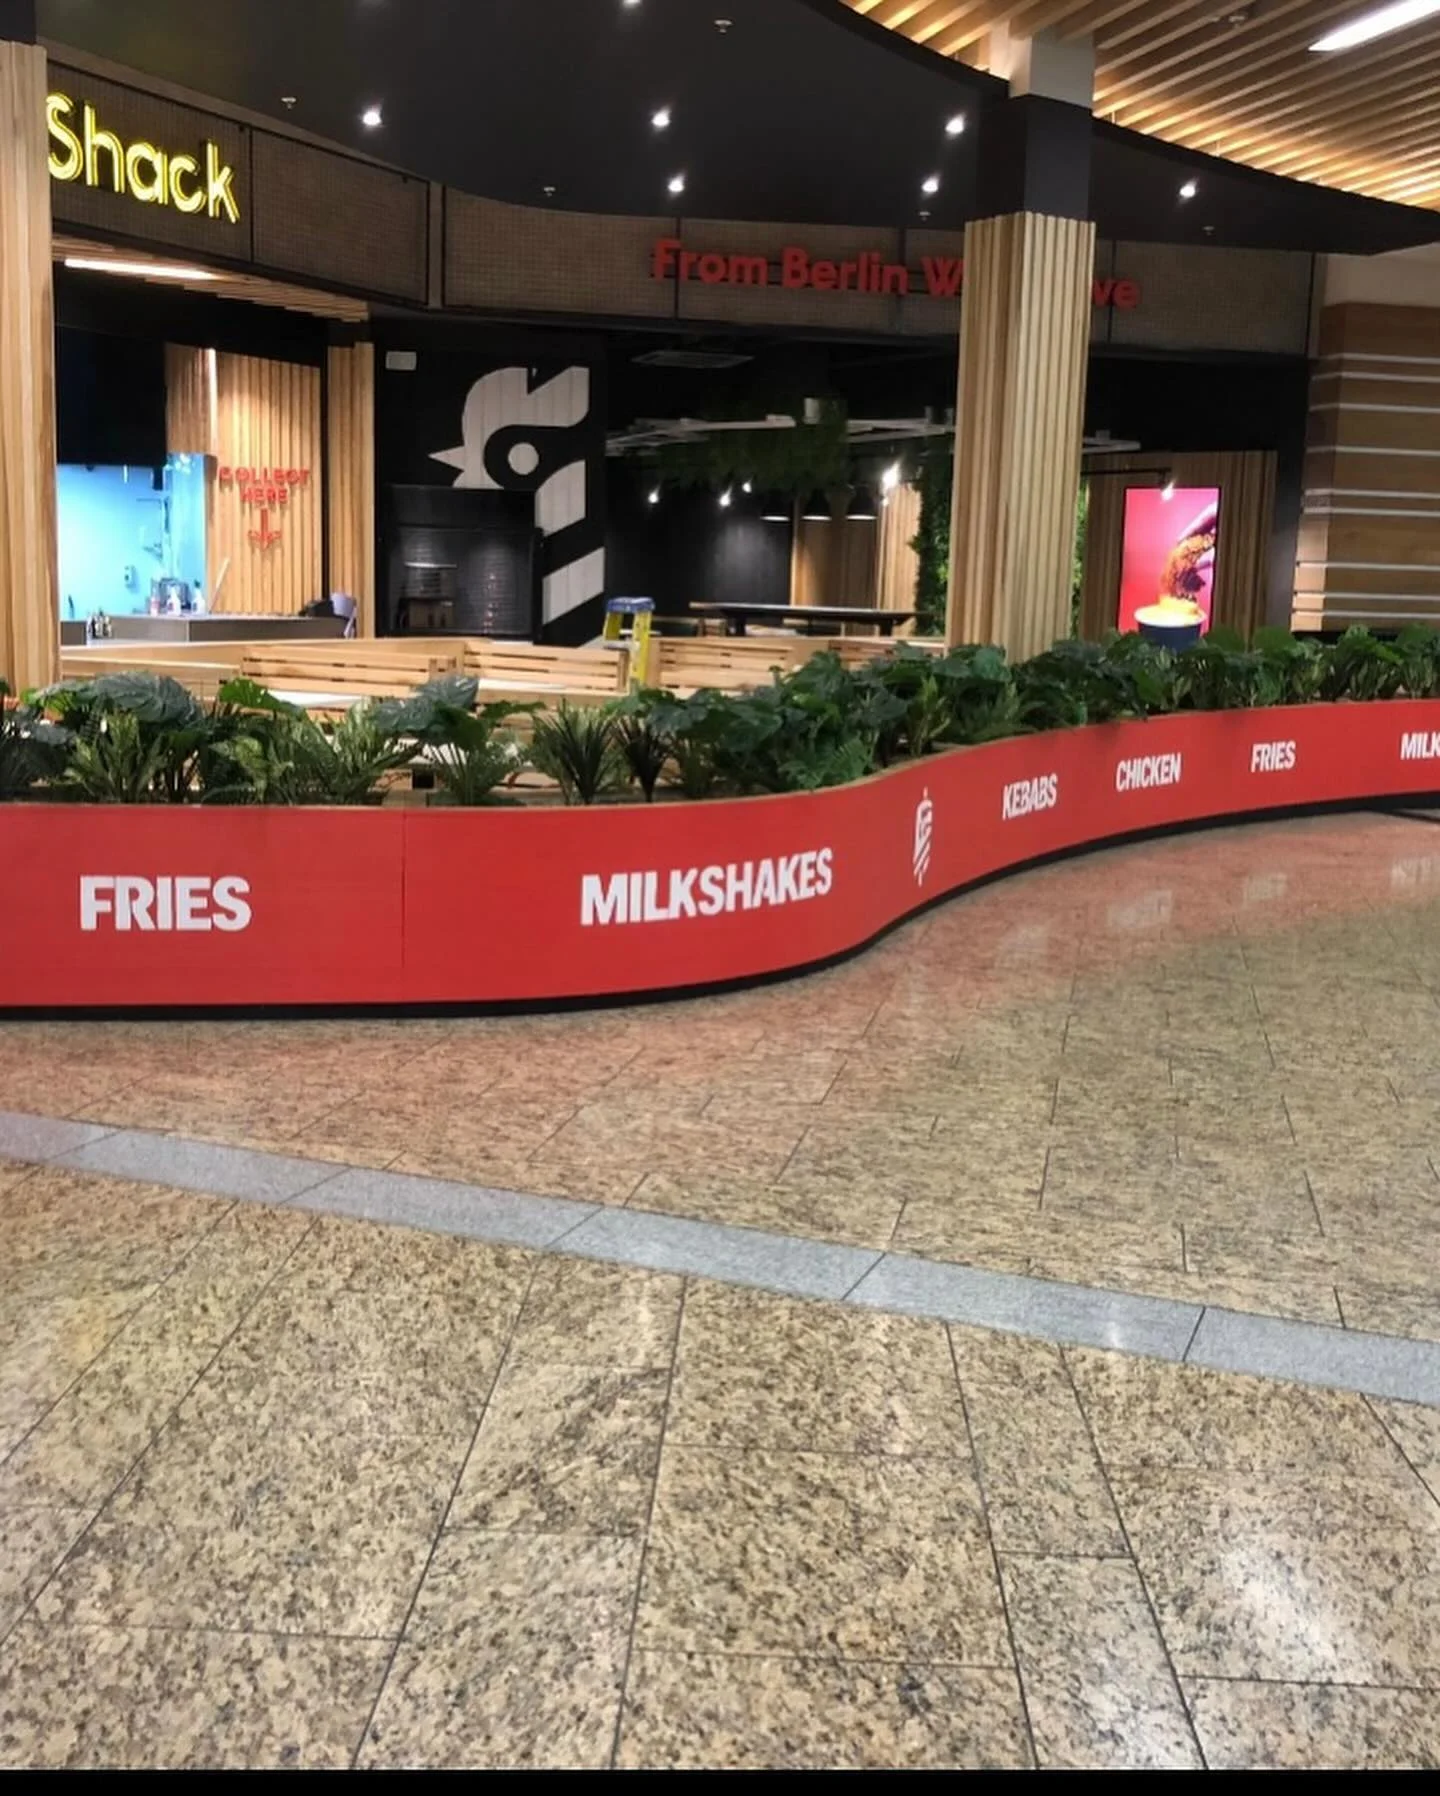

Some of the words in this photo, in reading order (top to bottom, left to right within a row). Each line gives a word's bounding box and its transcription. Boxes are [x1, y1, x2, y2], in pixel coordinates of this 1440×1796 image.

[46, 93, 240, 224] Shack
[652, 238, 767, 285] From
[781, 246, 908, 295] Berlin
[1092, 277, 1140, 309] ve
[218, 466, 309, 485] COLLECT
[240, 487, 288, 504] HERE
[79, 875, 252, 931] FRIES
[581, 848, 833, 925] MILKSHAKES
[1002, 773, 1058, 820] KEBABS
[1116, 752, 1182, 792] CHICKEN
[1251, 741, 1296, 772] FRIES
